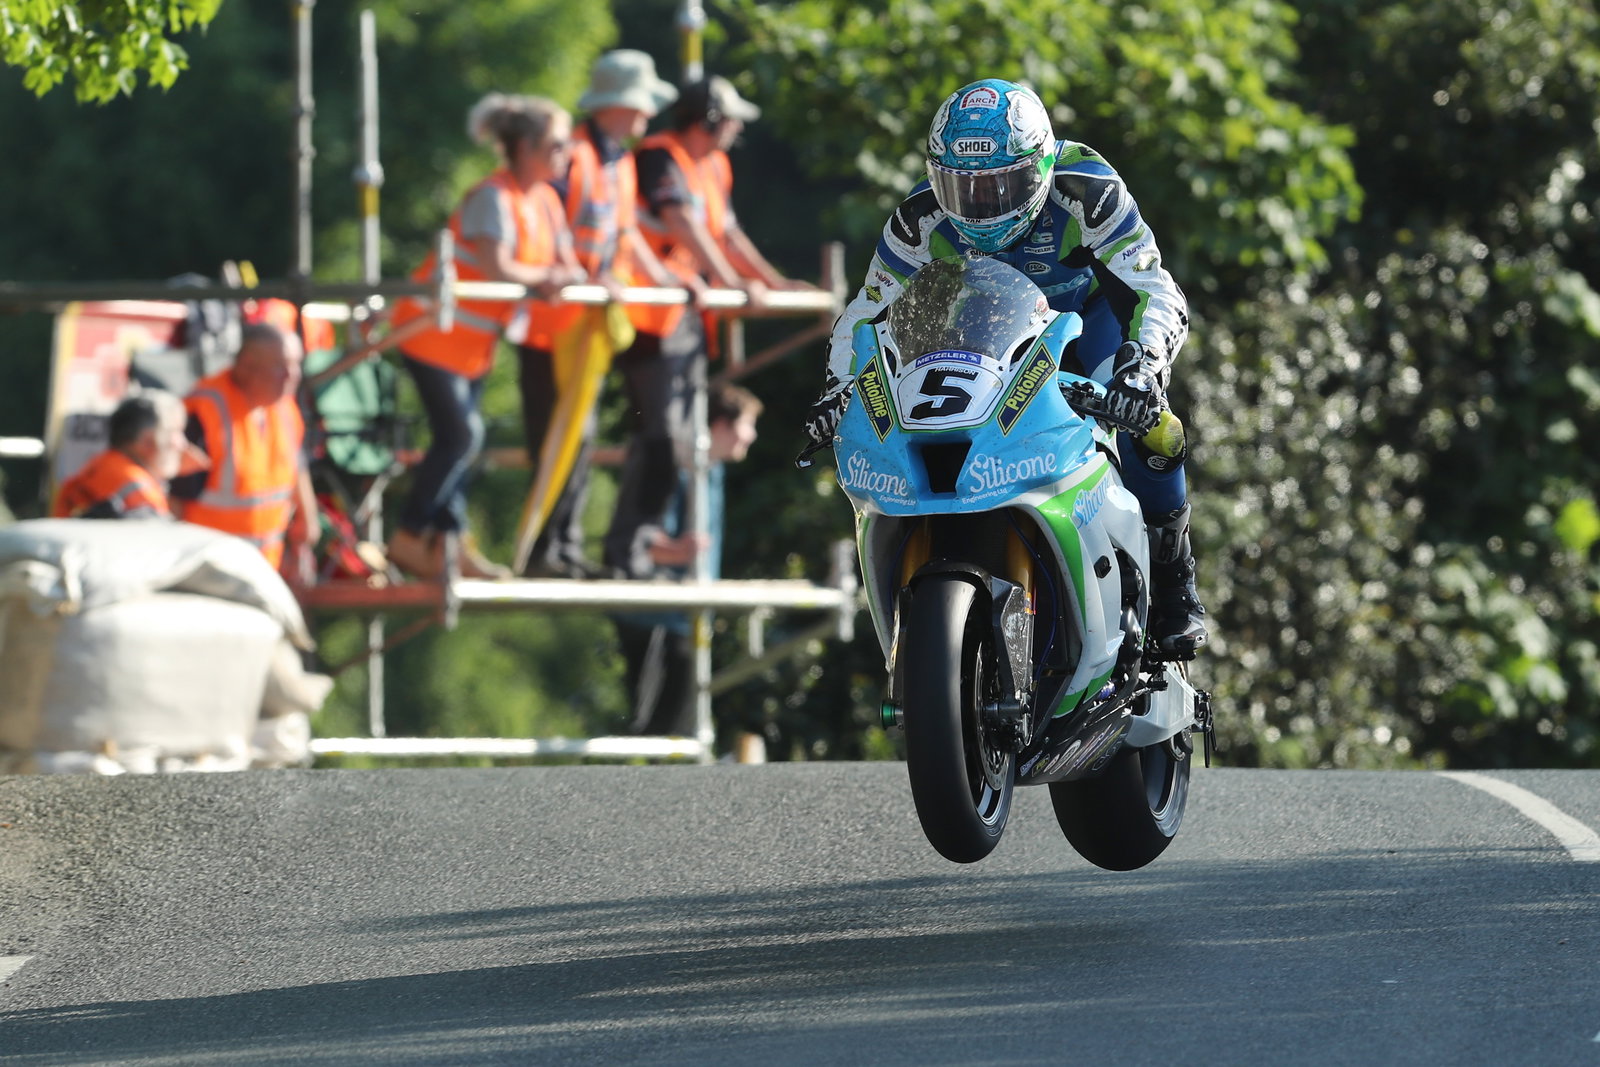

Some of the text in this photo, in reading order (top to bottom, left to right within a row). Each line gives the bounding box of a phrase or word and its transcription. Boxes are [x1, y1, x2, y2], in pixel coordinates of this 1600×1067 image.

[958, 140, 991, 153] SHOEI
[917, 352, 967, 367] METZELER
[934, 366, 976, 376] HARRISON
[860, 371, 888, 417] Putoline
[908, 367, 981, 421] 5
[1004, 359, 1050, 411] Putoline
[843, 450, 909, 497] Silicone
[968, 452, 1058, 494] Silicone
[961, 490, 998, 505] Engineering
